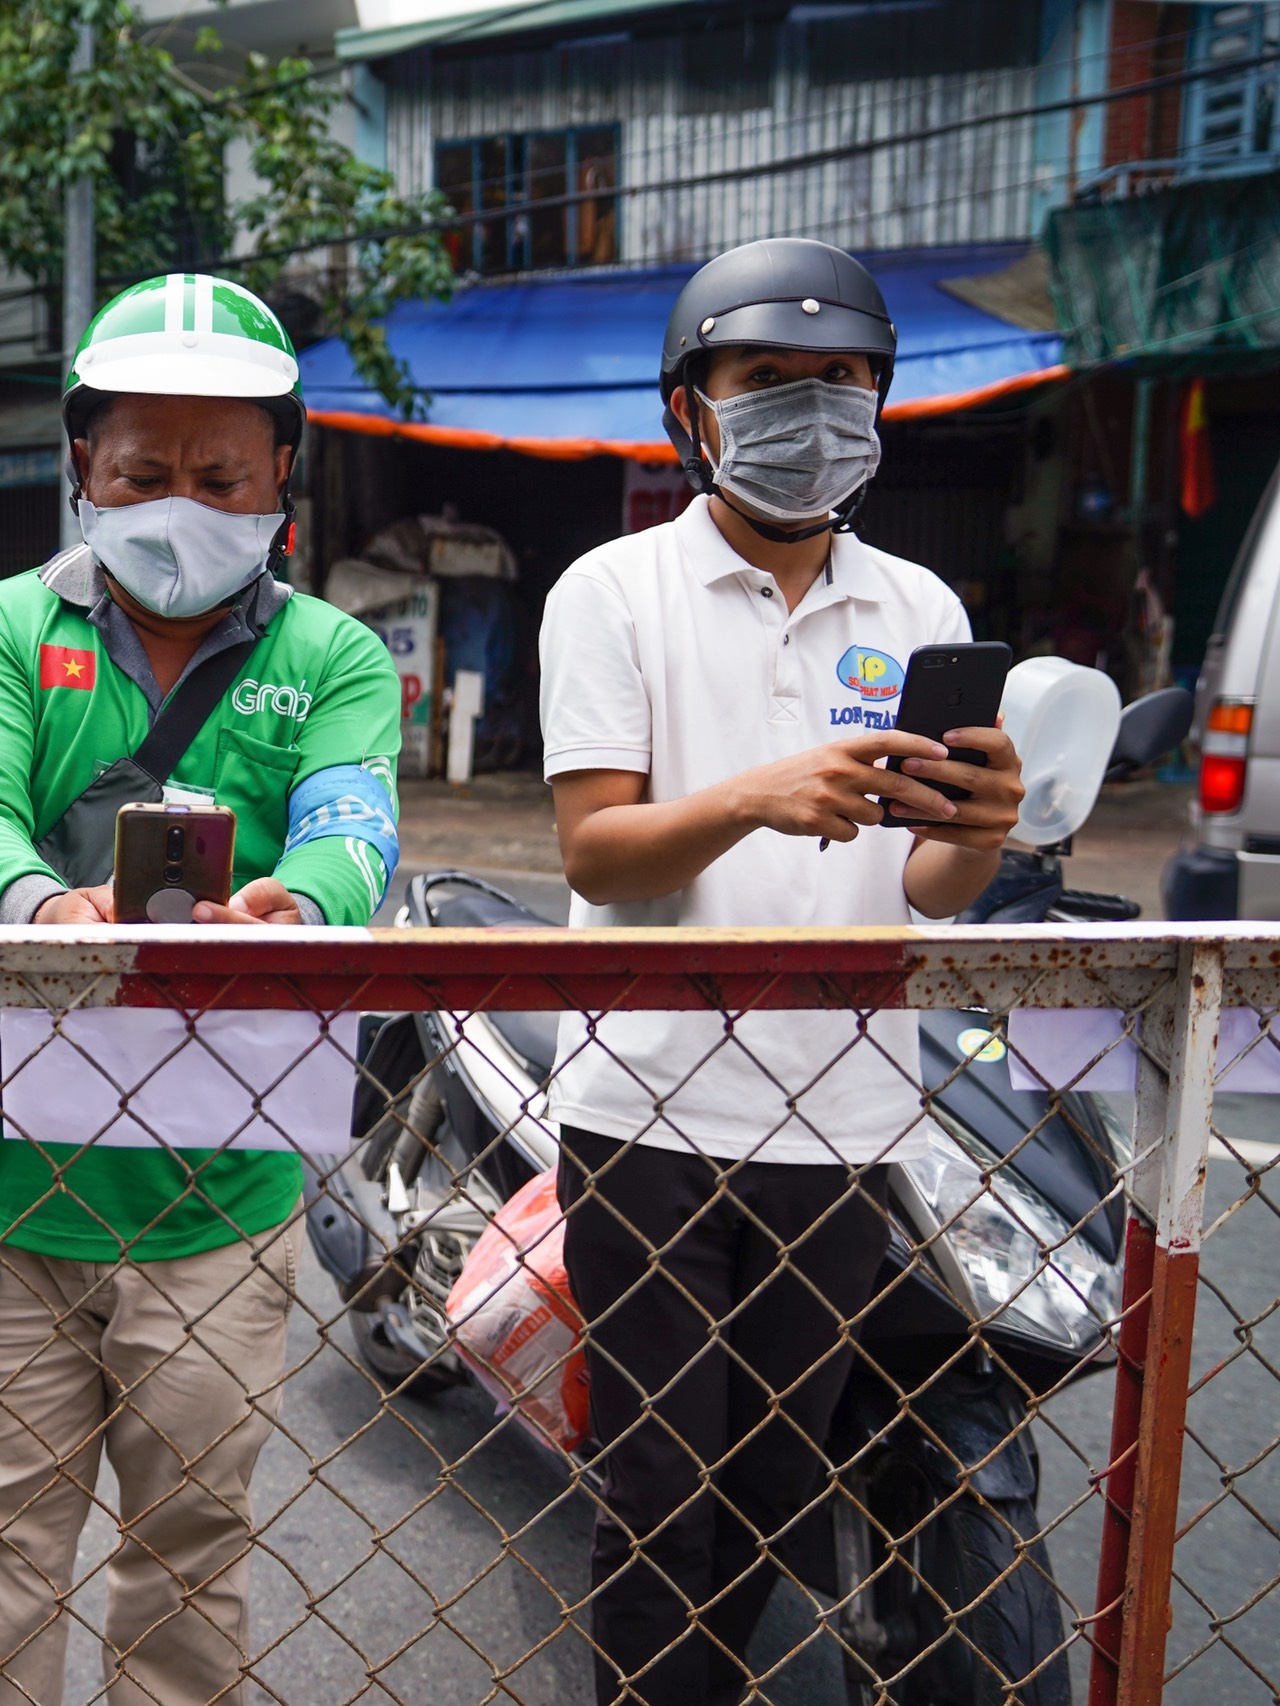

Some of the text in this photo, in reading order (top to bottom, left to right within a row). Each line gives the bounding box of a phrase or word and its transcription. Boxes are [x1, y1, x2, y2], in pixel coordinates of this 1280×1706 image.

[232, 678, 312, 722] Grab
[880, 684, 898, 697] MILK
[830, 706, 863, 725] LON
